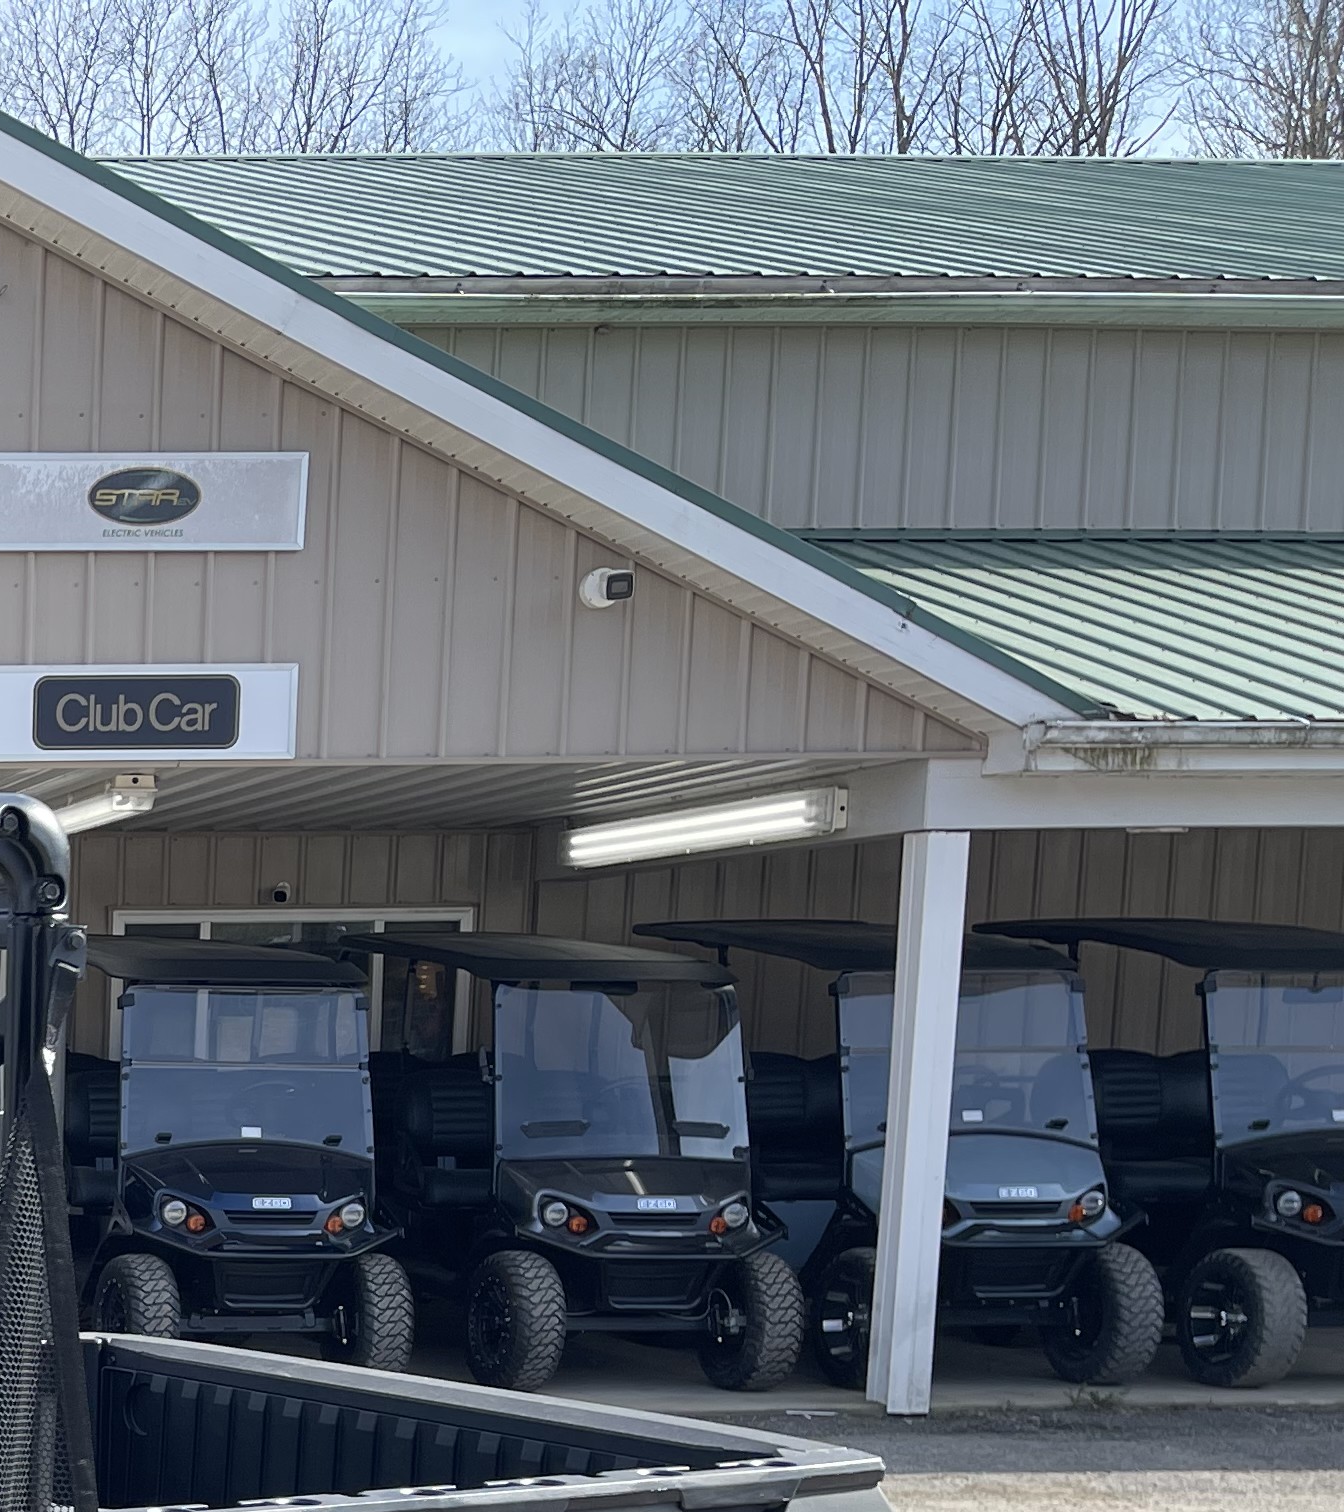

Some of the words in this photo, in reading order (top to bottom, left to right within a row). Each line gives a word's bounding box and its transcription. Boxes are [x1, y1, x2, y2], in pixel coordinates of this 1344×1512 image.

[94, 488, 180, 506] STAR
[102, 529, 141, 538] ELECTRIC
[144, 529, 184, 538] VEHICLES
[55, 693, 143, 733] Club
[149, 692, 217, 732] Car
